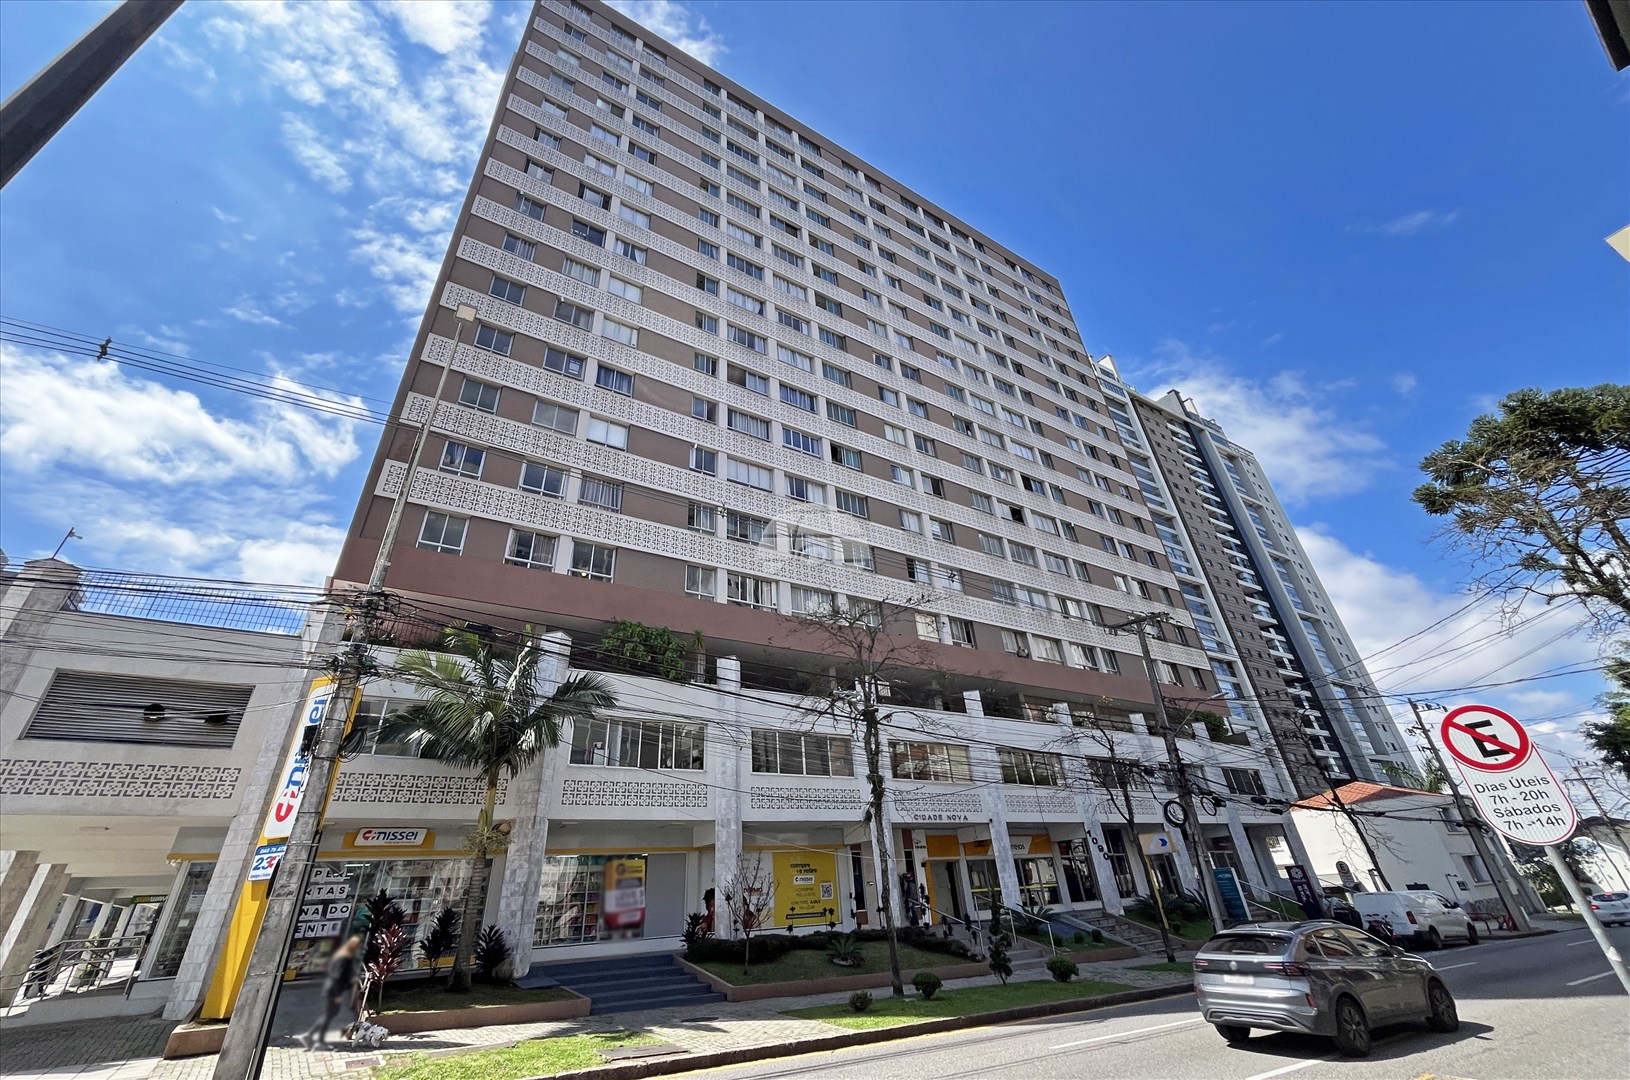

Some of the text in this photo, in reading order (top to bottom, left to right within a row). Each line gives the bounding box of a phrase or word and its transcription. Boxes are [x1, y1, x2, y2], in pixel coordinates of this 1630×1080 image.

[1474, 776, 1550, 794] Dias Úteis
[1489, 794, 1508, 804] 7h
[1520, 790, 1550, 801] 20h
[1493, 804, 1561, 818] Sábados
[1503, 820, 1524, 830] 7h
[1536, 816, 1566, 828] 14h
[376, 832, 418, 840] nissei
[1086, 830, 1110, 860] 1090
[329, 905, 349, 915] DO
